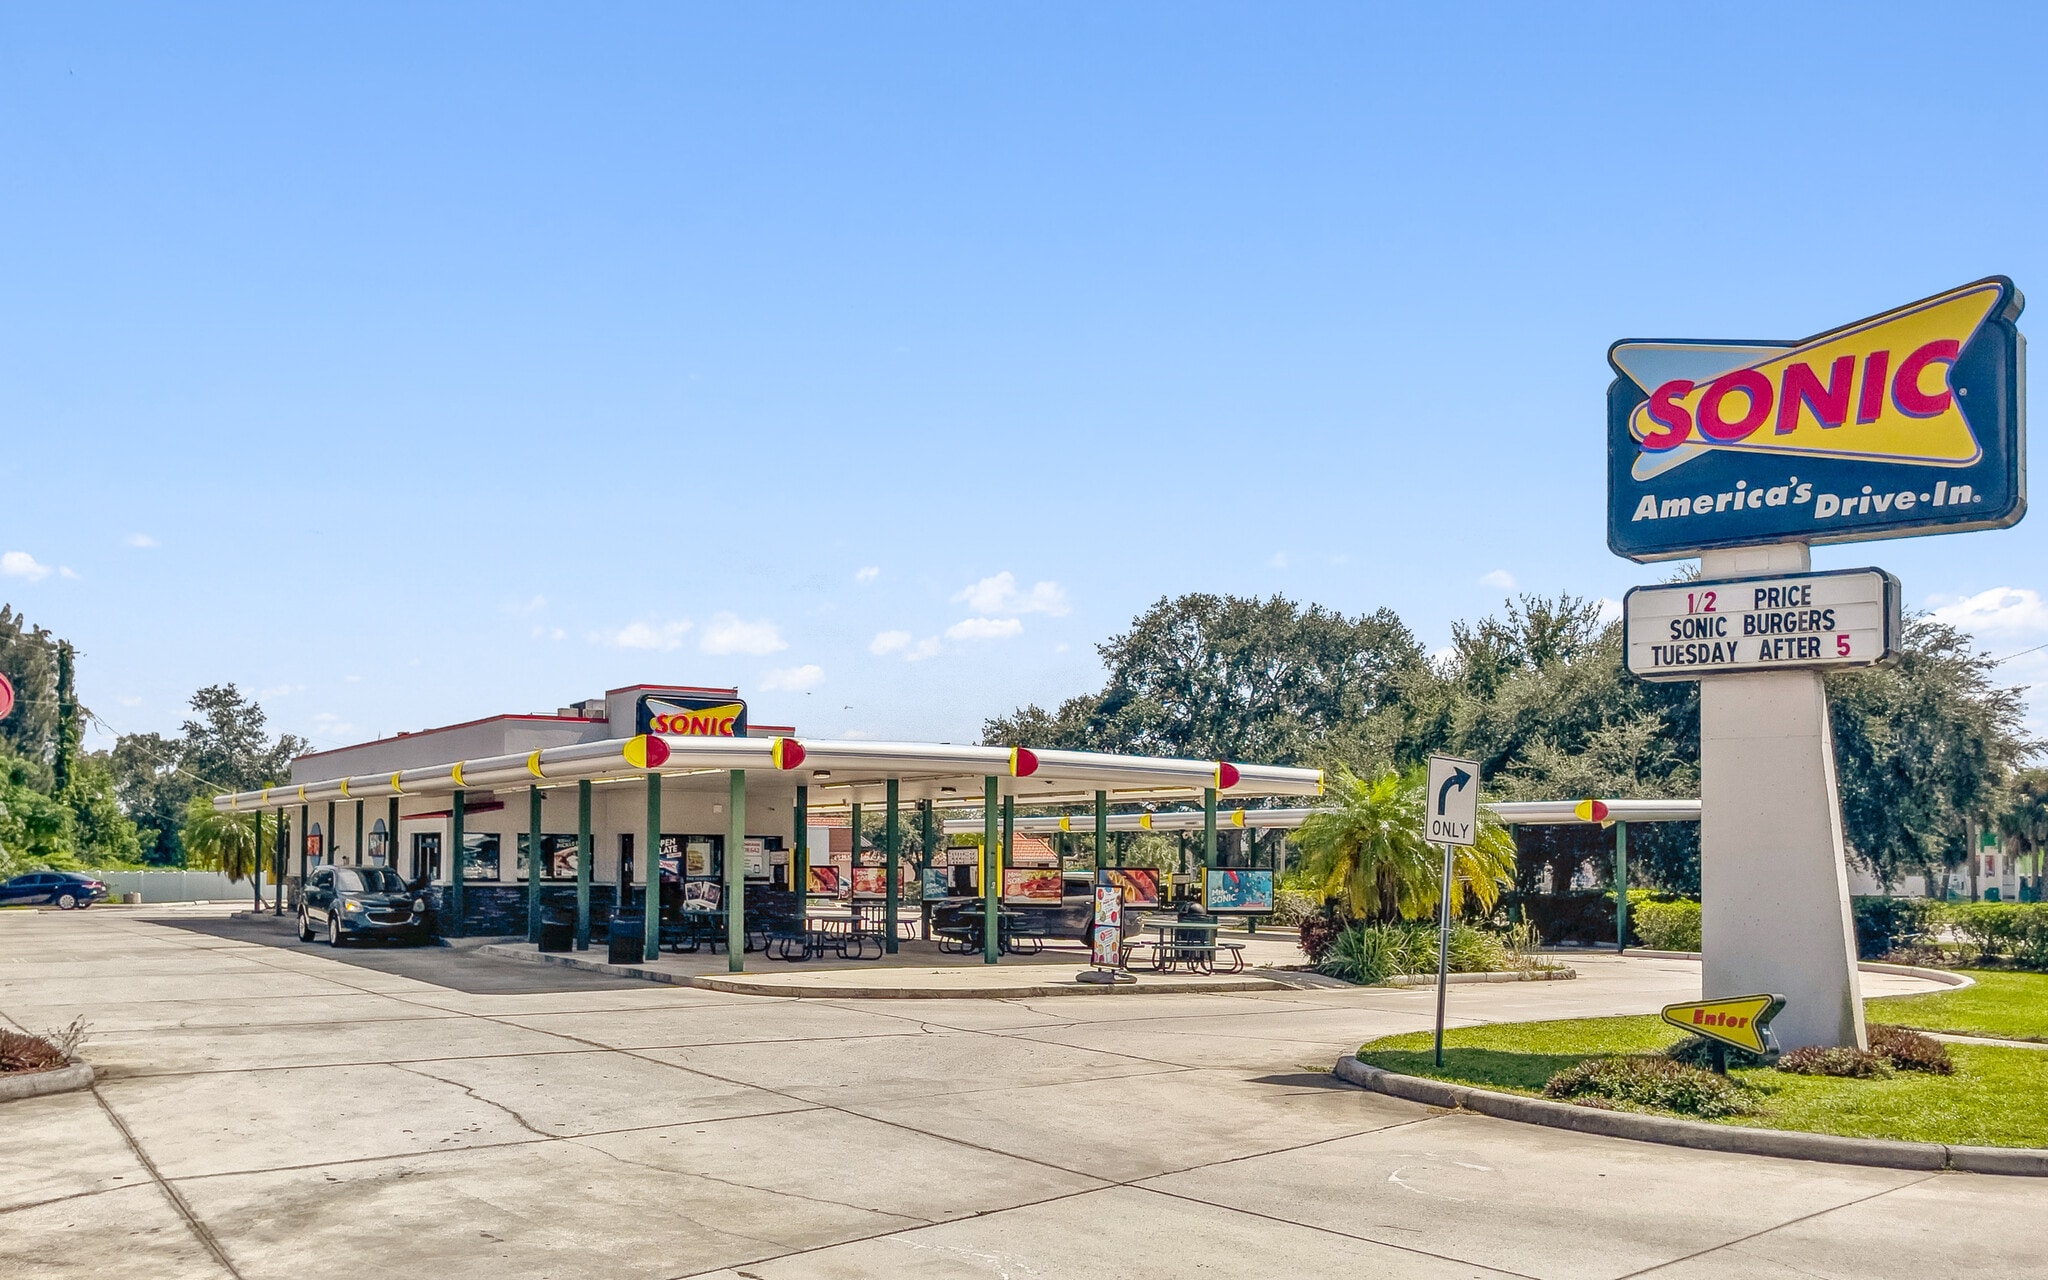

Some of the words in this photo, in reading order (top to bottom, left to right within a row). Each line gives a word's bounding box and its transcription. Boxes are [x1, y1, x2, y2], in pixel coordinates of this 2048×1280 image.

[1639, 339, 1960, 453] SONIC
[1631, 476, 1813, 522] America's
[1687, 591, 1717, 615] 1/2
[1754, 584, 1812, 610] PRICE
[1670, 616, 1728, 641] SONIC
[1743, 609, 1836, 636] BURGERS
[1651, 641, 1739, 666] TUESDAY
[1759, 636, 1821, 660] AFTER
[1836, 634, 1851, 657] 5
[654, 712, 735, 737] SONIC
[1432, 820, 1469, 839] ONLY
[659, 845, 678, 854] LATE
[660, 838, 676, 847] PEN
[1211, 893, 1237, 904] SONIC
[1692, 1009, 1749, 1029] Enter
